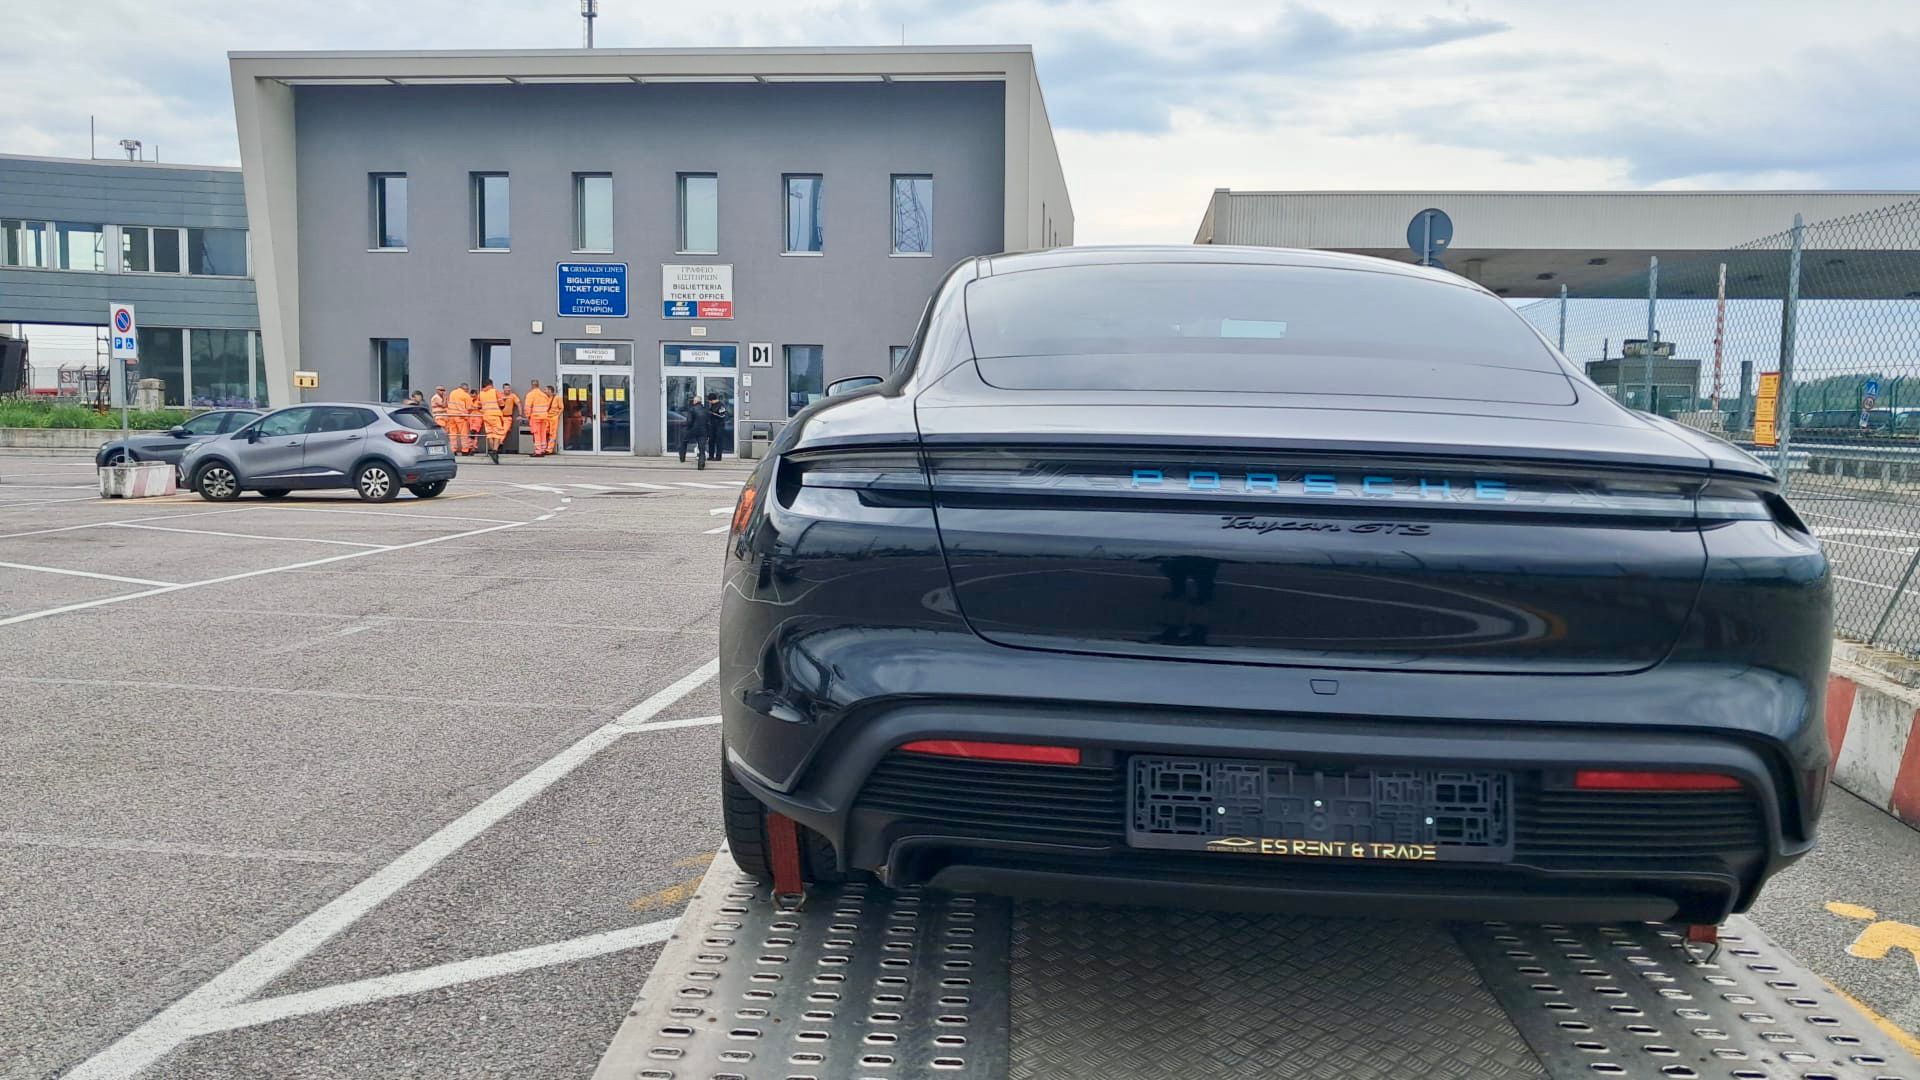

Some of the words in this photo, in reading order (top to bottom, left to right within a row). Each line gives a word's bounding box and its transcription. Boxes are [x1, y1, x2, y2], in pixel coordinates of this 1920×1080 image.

[566, 277, 618, 285] BIGLIETTERIA
[593, 285, 621, 293] OFFICE
[752, 346, 769, 363] D1
[1131, 469, 1508, 501] PORSCHE
[1221, 515, 1341, 535] Taycan
[1349, 522, 1431, 536] GTS
[1261, 838, 1288, 855] ES
[1292, 840, 1346, 856] RENT
[1351, 842, 1365, 858] &
[1370, 843, 1436, 860] TRADE
